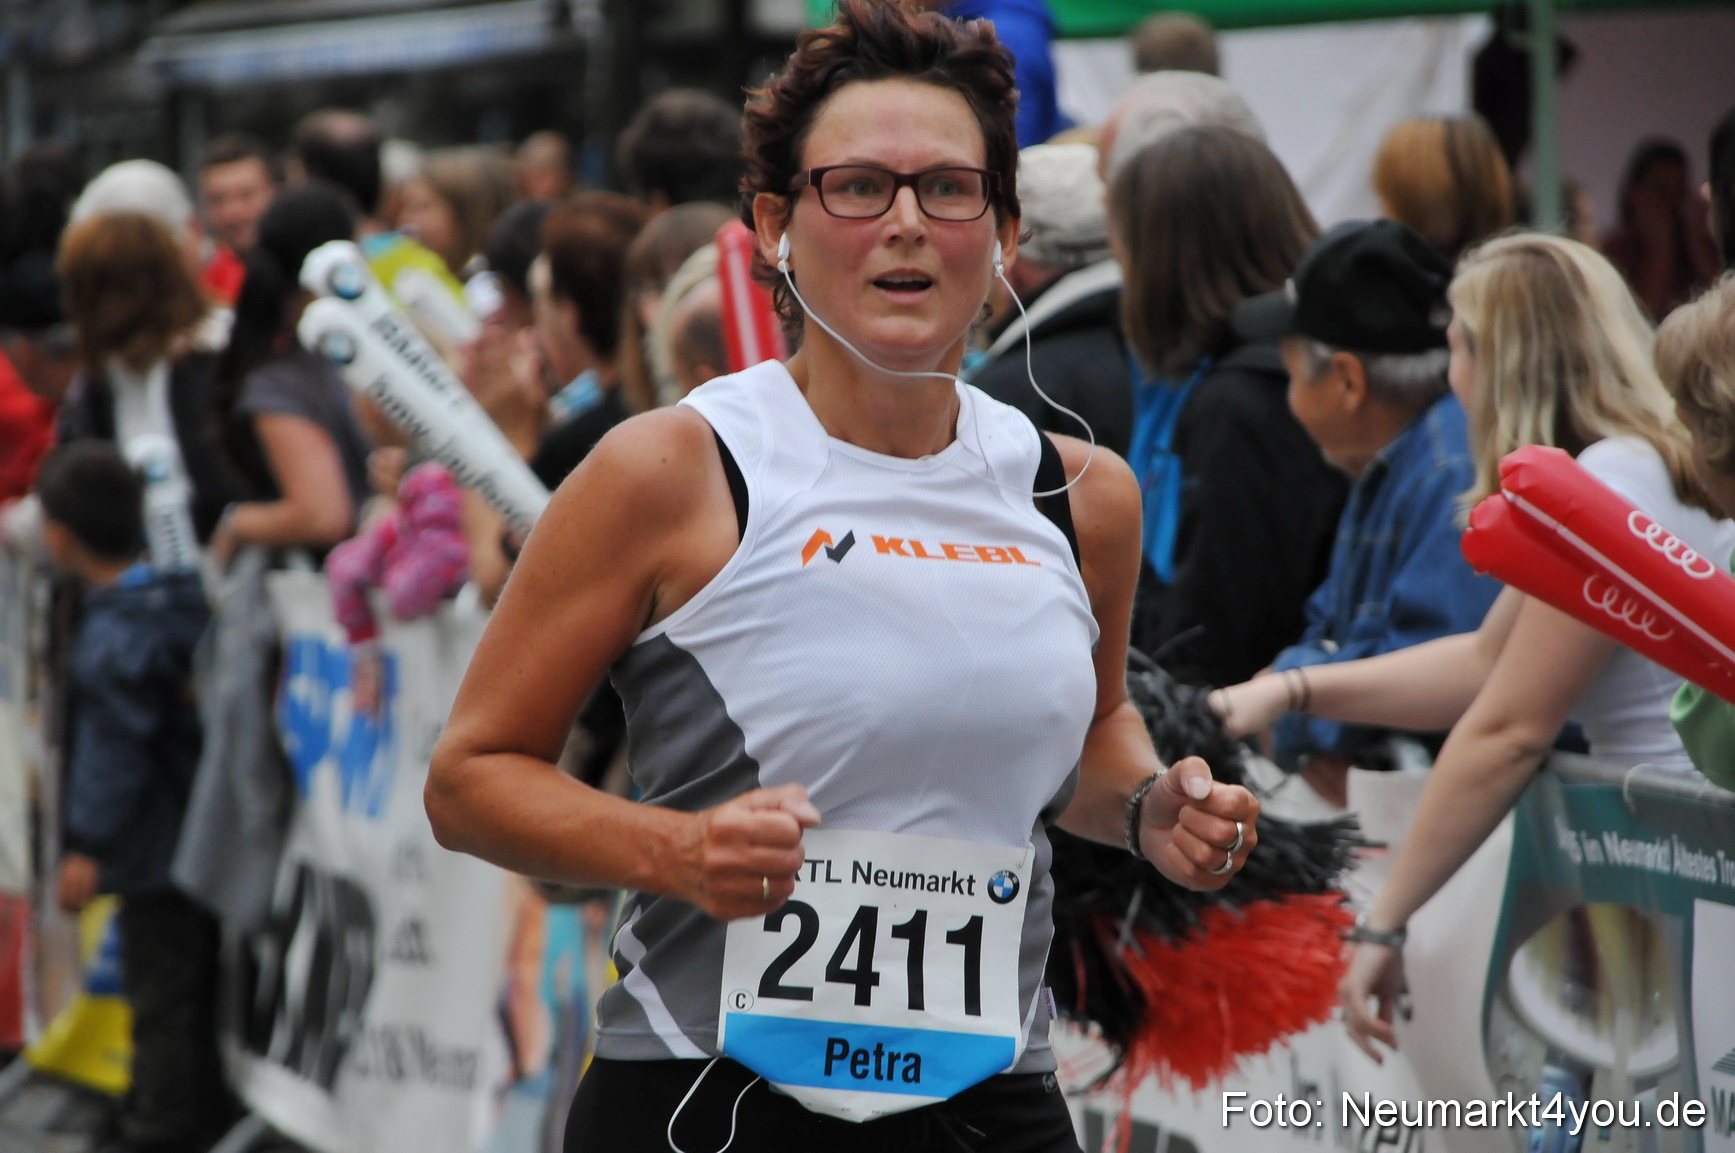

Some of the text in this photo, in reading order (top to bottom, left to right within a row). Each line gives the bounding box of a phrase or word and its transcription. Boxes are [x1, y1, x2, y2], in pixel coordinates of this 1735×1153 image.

[870, 534, 1042, 567] KLEBL
[794, 858, 976, 896] TL Neumarkt
[757, 898, 984, 1017] 2411
[735, 992, 747, 1010] C
[823, 1037, 922, 1084] Petra
